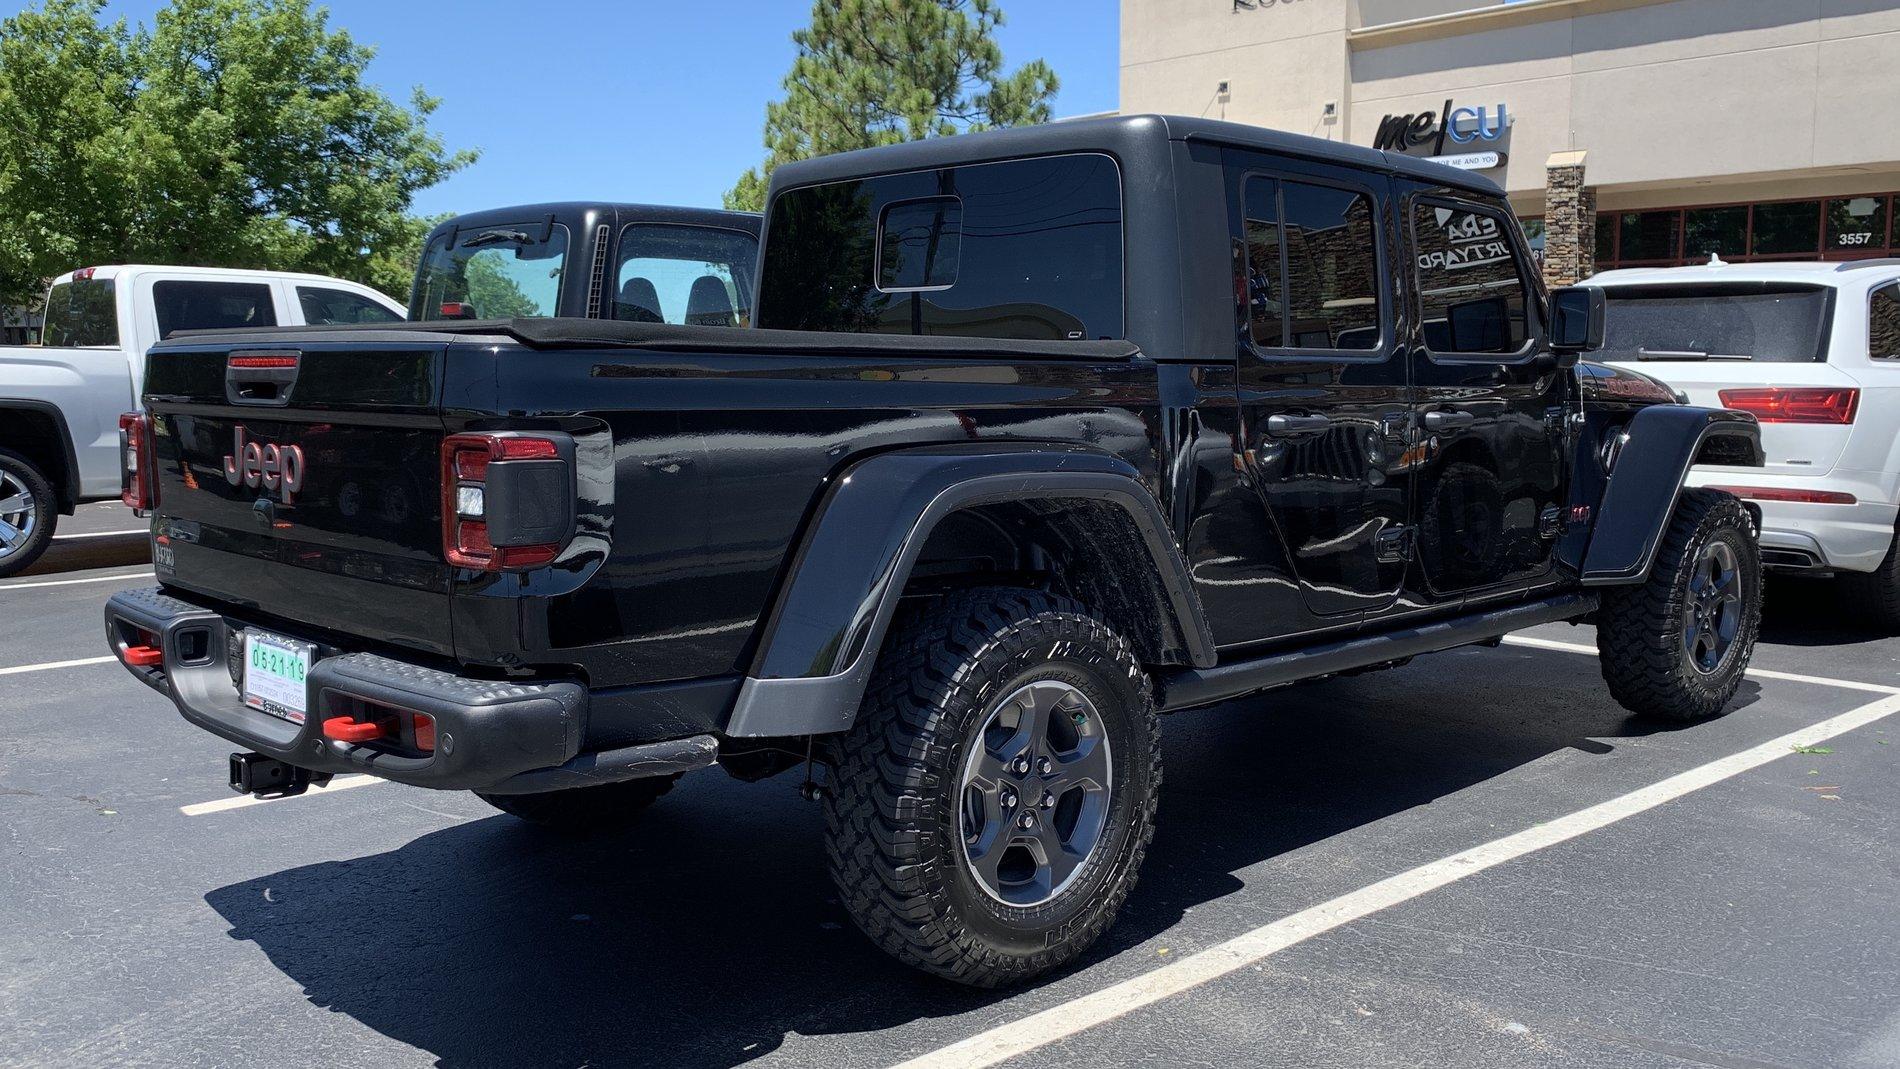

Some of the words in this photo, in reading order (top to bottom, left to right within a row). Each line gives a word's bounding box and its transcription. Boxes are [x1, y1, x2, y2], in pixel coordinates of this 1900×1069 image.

[1464, 157, 1479, 165] AND
[1482, 155, 1497, 163] YOU
[1839, 232, 1872, 245] 3557
[223, 425, 304, 505] Jeep
